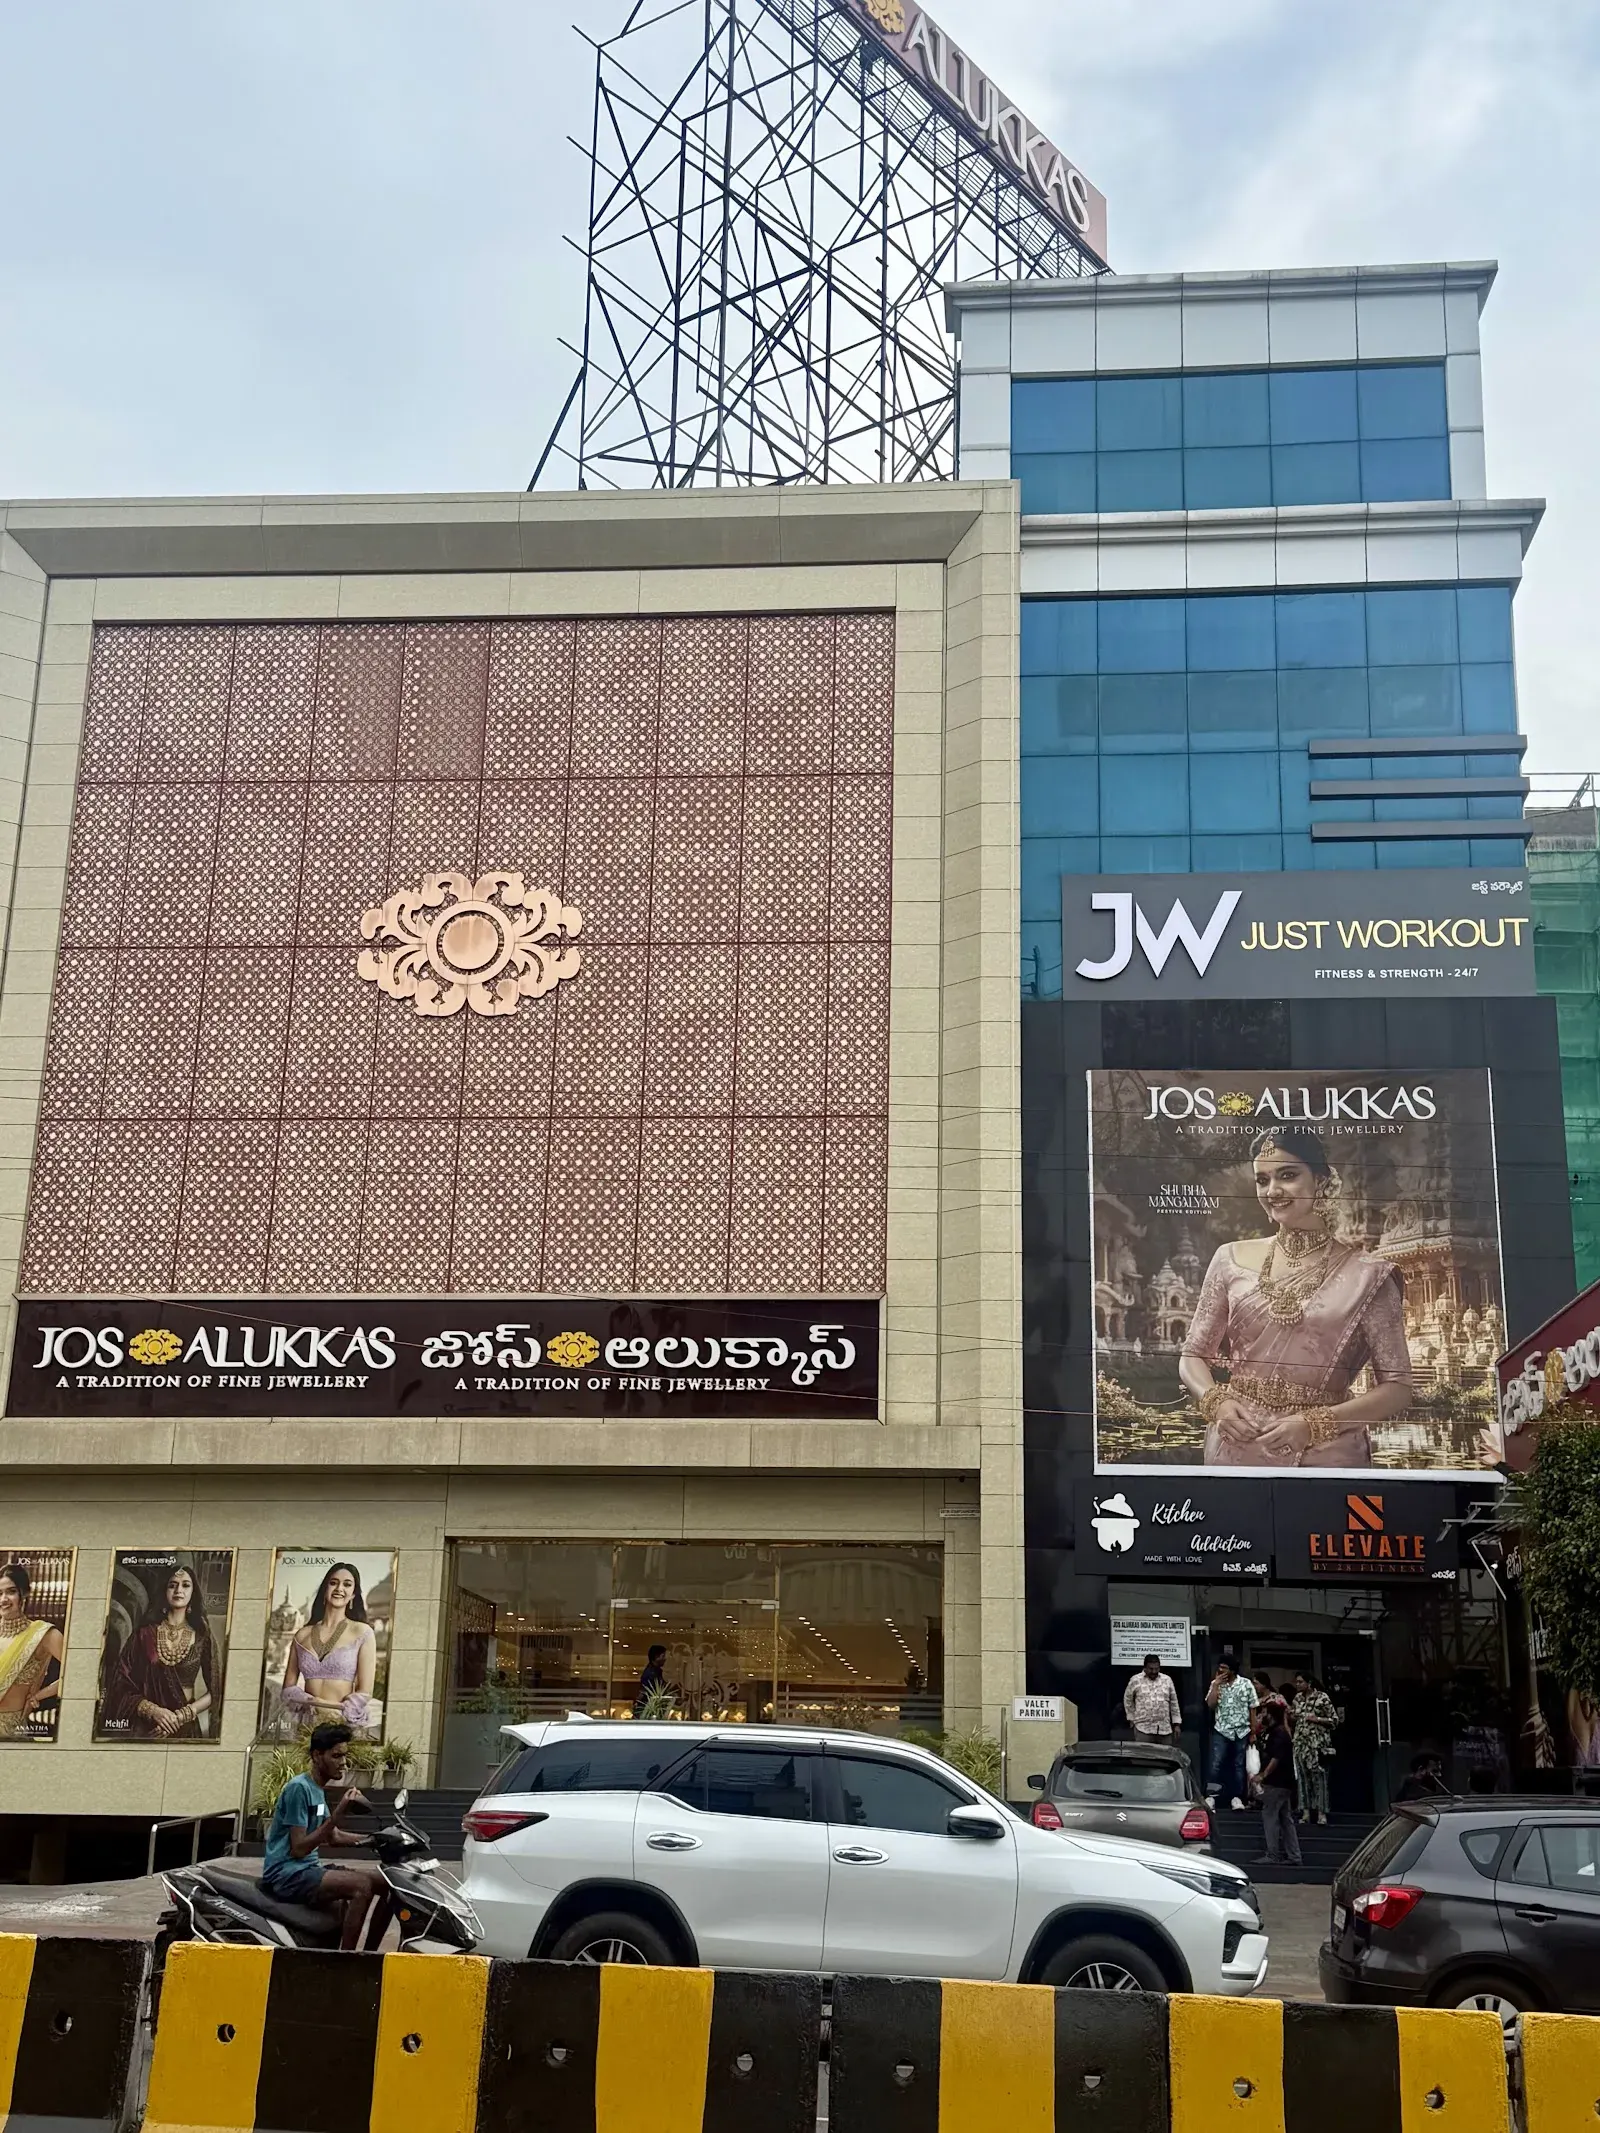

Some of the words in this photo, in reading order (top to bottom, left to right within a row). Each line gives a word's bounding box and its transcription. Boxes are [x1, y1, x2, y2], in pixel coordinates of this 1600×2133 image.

[902, 12, 1090, 233] ALUKKAS
[1075, 889, 1243, 980] JW
[1240, 920, 1330, 951] JUST
[1336, 918, 1530, 949] WORKOUT
[1314, 968, 1365, 979] FITNESS
[1366, 968, 1377, 978] &
[1379, 968, 1444, 979] STRENGTH
[1454, 967, 1480, 979] 24/7
[1143, 1086, 1216, 1120] JOS
[1254, 1085, 1438, 1121] ALUKKAS
[1175, 1124, 1184, 1135] A
[1189, 1125, 1265, 1135] TRADITION
[1270, 1125, 1288, 1135] OF
[1294, 1126, 1325, 1136] FINE
[1330, 1125, 1405, 1136] JEWELLERY
[1160, 1183, 1207, 1196] SHUBHA
[1148, 1195, 1220, 1209] MANGALYAM
[33, 1326, 125, 1370] JOS
[182, 1325, 397, 1370] ALUKKAS
[421, 1323, 542, 1369] జోస్
[56, 1375, 69, 1388] A
[76, 1375, 183, 1388] TRADITION
[188, 1375, 213, 1388] OF
[218, 1375, 262, 1388] FINE
[267, 1375, 369, 1390] JEWELLERY
[455, 1377, 468, 1390] A
[474, 1377, 580, 1390] TRADITION
[587, 1377, 611, 1390] OF
[618, 1377, 662, 1391] FINE
[667, 1377, 771, 1393] JEWELLERY
[1151, 1498, 1206, 1524] Kitchen
[1190, 1534, 1253, 1552] Addiction
[1310, 1533, 1426, 1559] ELEVATE
[281, 1557, 296, 1565] JOS
[302, 1556, 336, 1565] ALUKKAS
[1360, 1564, 1426, 1573] FITNESS
[1024, 1700, 1050, 1708] VALET
[1019, 1709, 1055, 1717] PARKING
[105, 1719, 129, 1729] Mehfil
